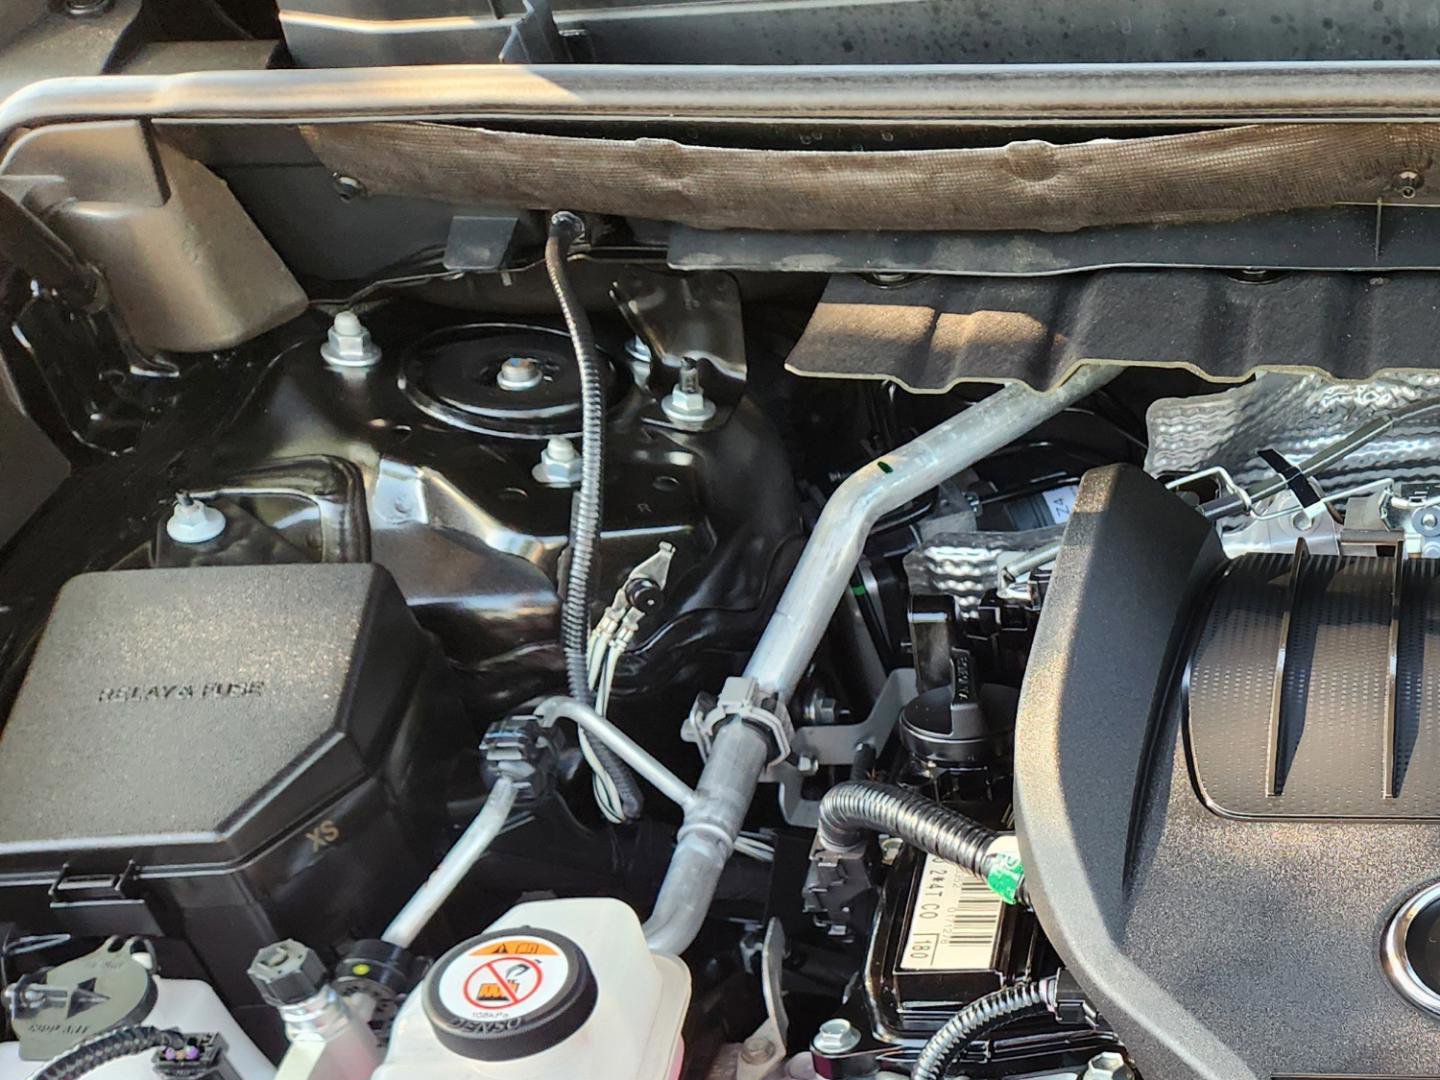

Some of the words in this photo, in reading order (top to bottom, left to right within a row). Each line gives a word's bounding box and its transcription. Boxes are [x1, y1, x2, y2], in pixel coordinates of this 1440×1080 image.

[99, 682, 176, 702] RELAY
[305, 820, 339, 853] XS
[911, 940, 930, 958] 180
